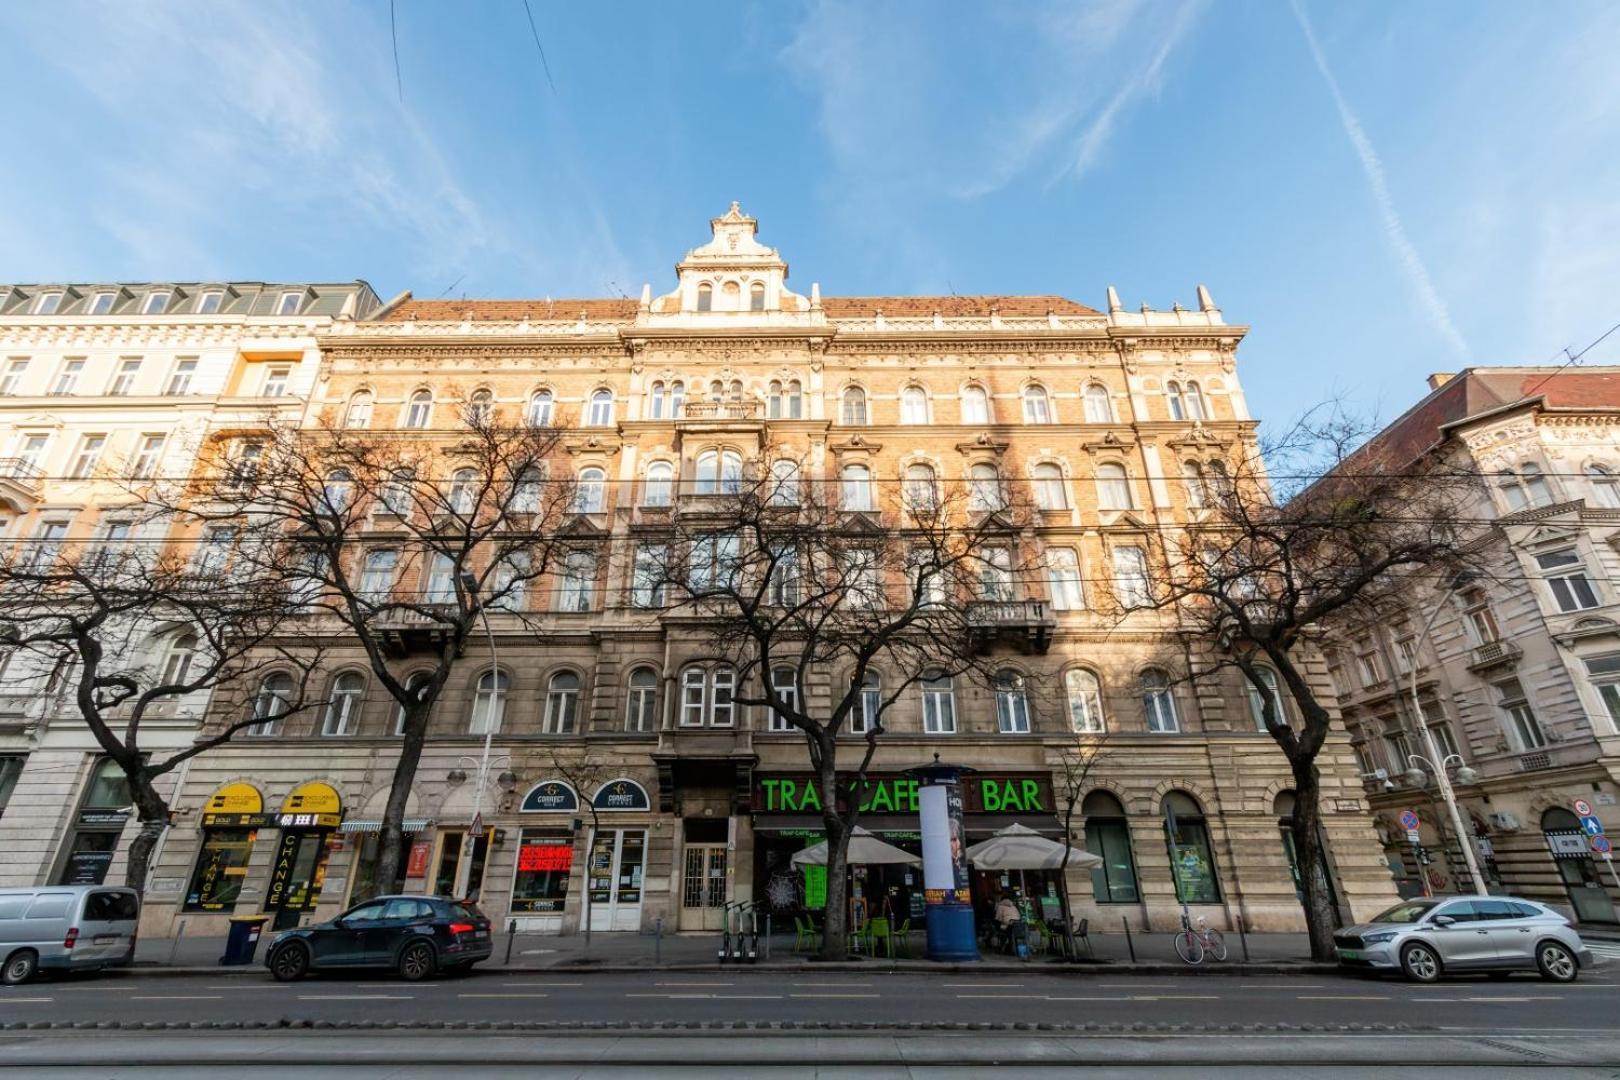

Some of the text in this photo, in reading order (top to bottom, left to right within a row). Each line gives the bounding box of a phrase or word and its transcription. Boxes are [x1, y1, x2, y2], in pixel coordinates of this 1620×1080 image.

[761, 779, 822, 811] TRA
[981, 780, 1043, 811] BAR
[201, 848, 222, 902] HANGE
[270, 835, 296, 904] CHANGE
